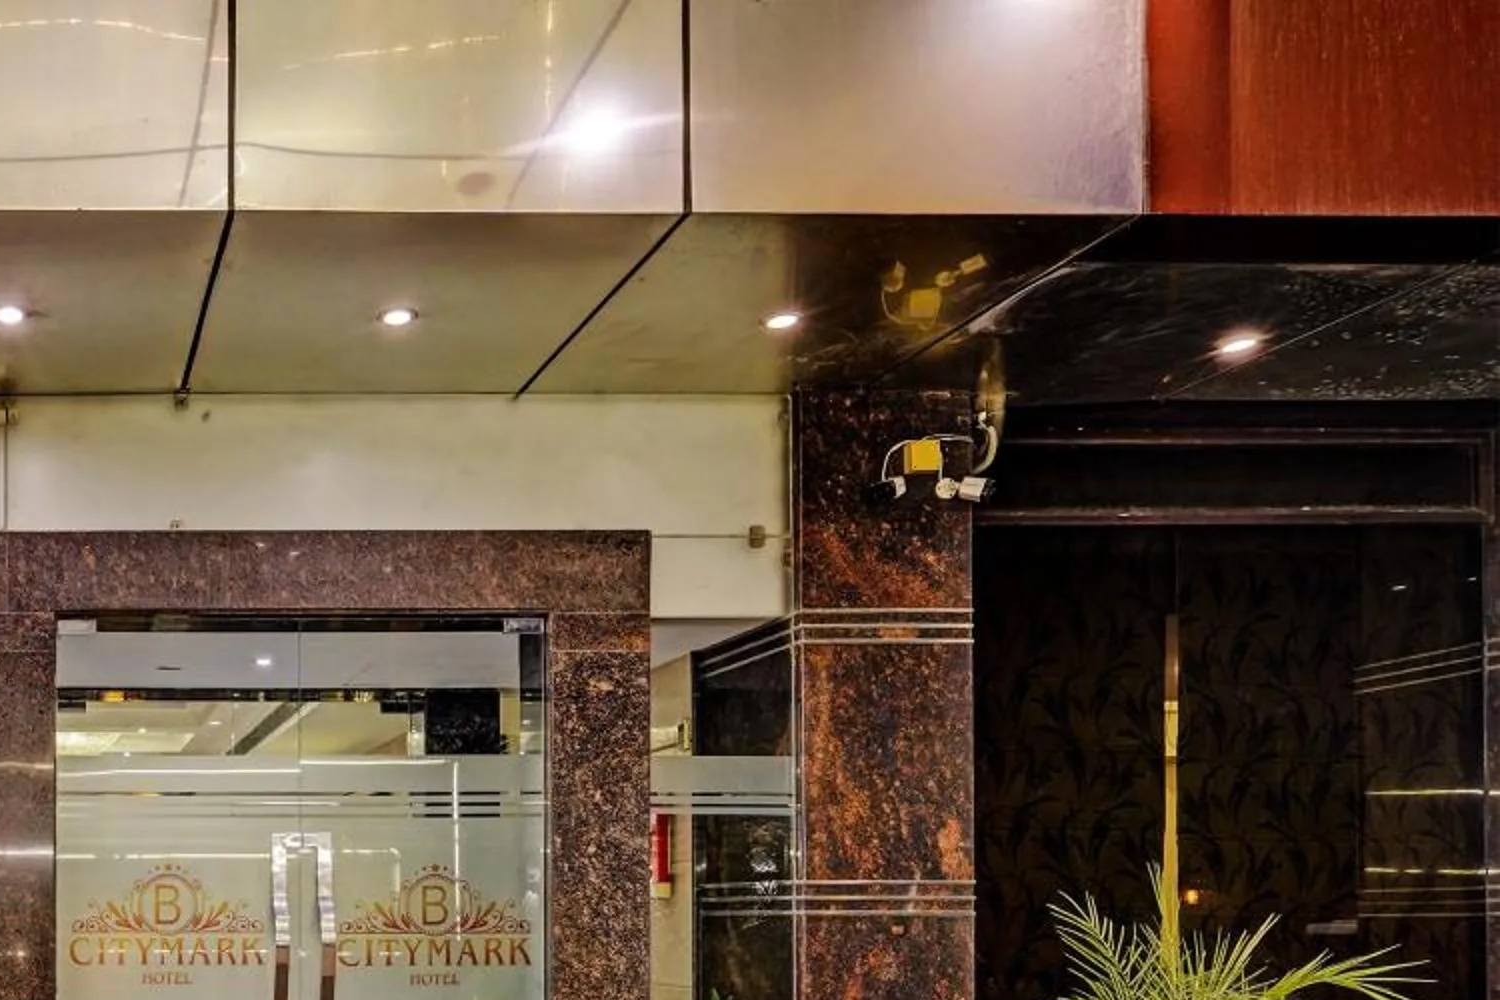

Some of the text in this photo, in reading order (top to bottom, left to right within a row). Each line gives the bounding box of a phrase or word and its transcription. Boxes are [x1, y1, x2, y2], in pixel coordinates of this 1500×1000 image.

[155, 885, 181, 925] B
[422, 885, 449, 926] B
[68, 936, 265, 966] CITYMARK
[337, 937, 532, 967] CITYMARK
[141, 972, 193, 985] HOTEL
[409, 973, 461, 986] HOTEL
